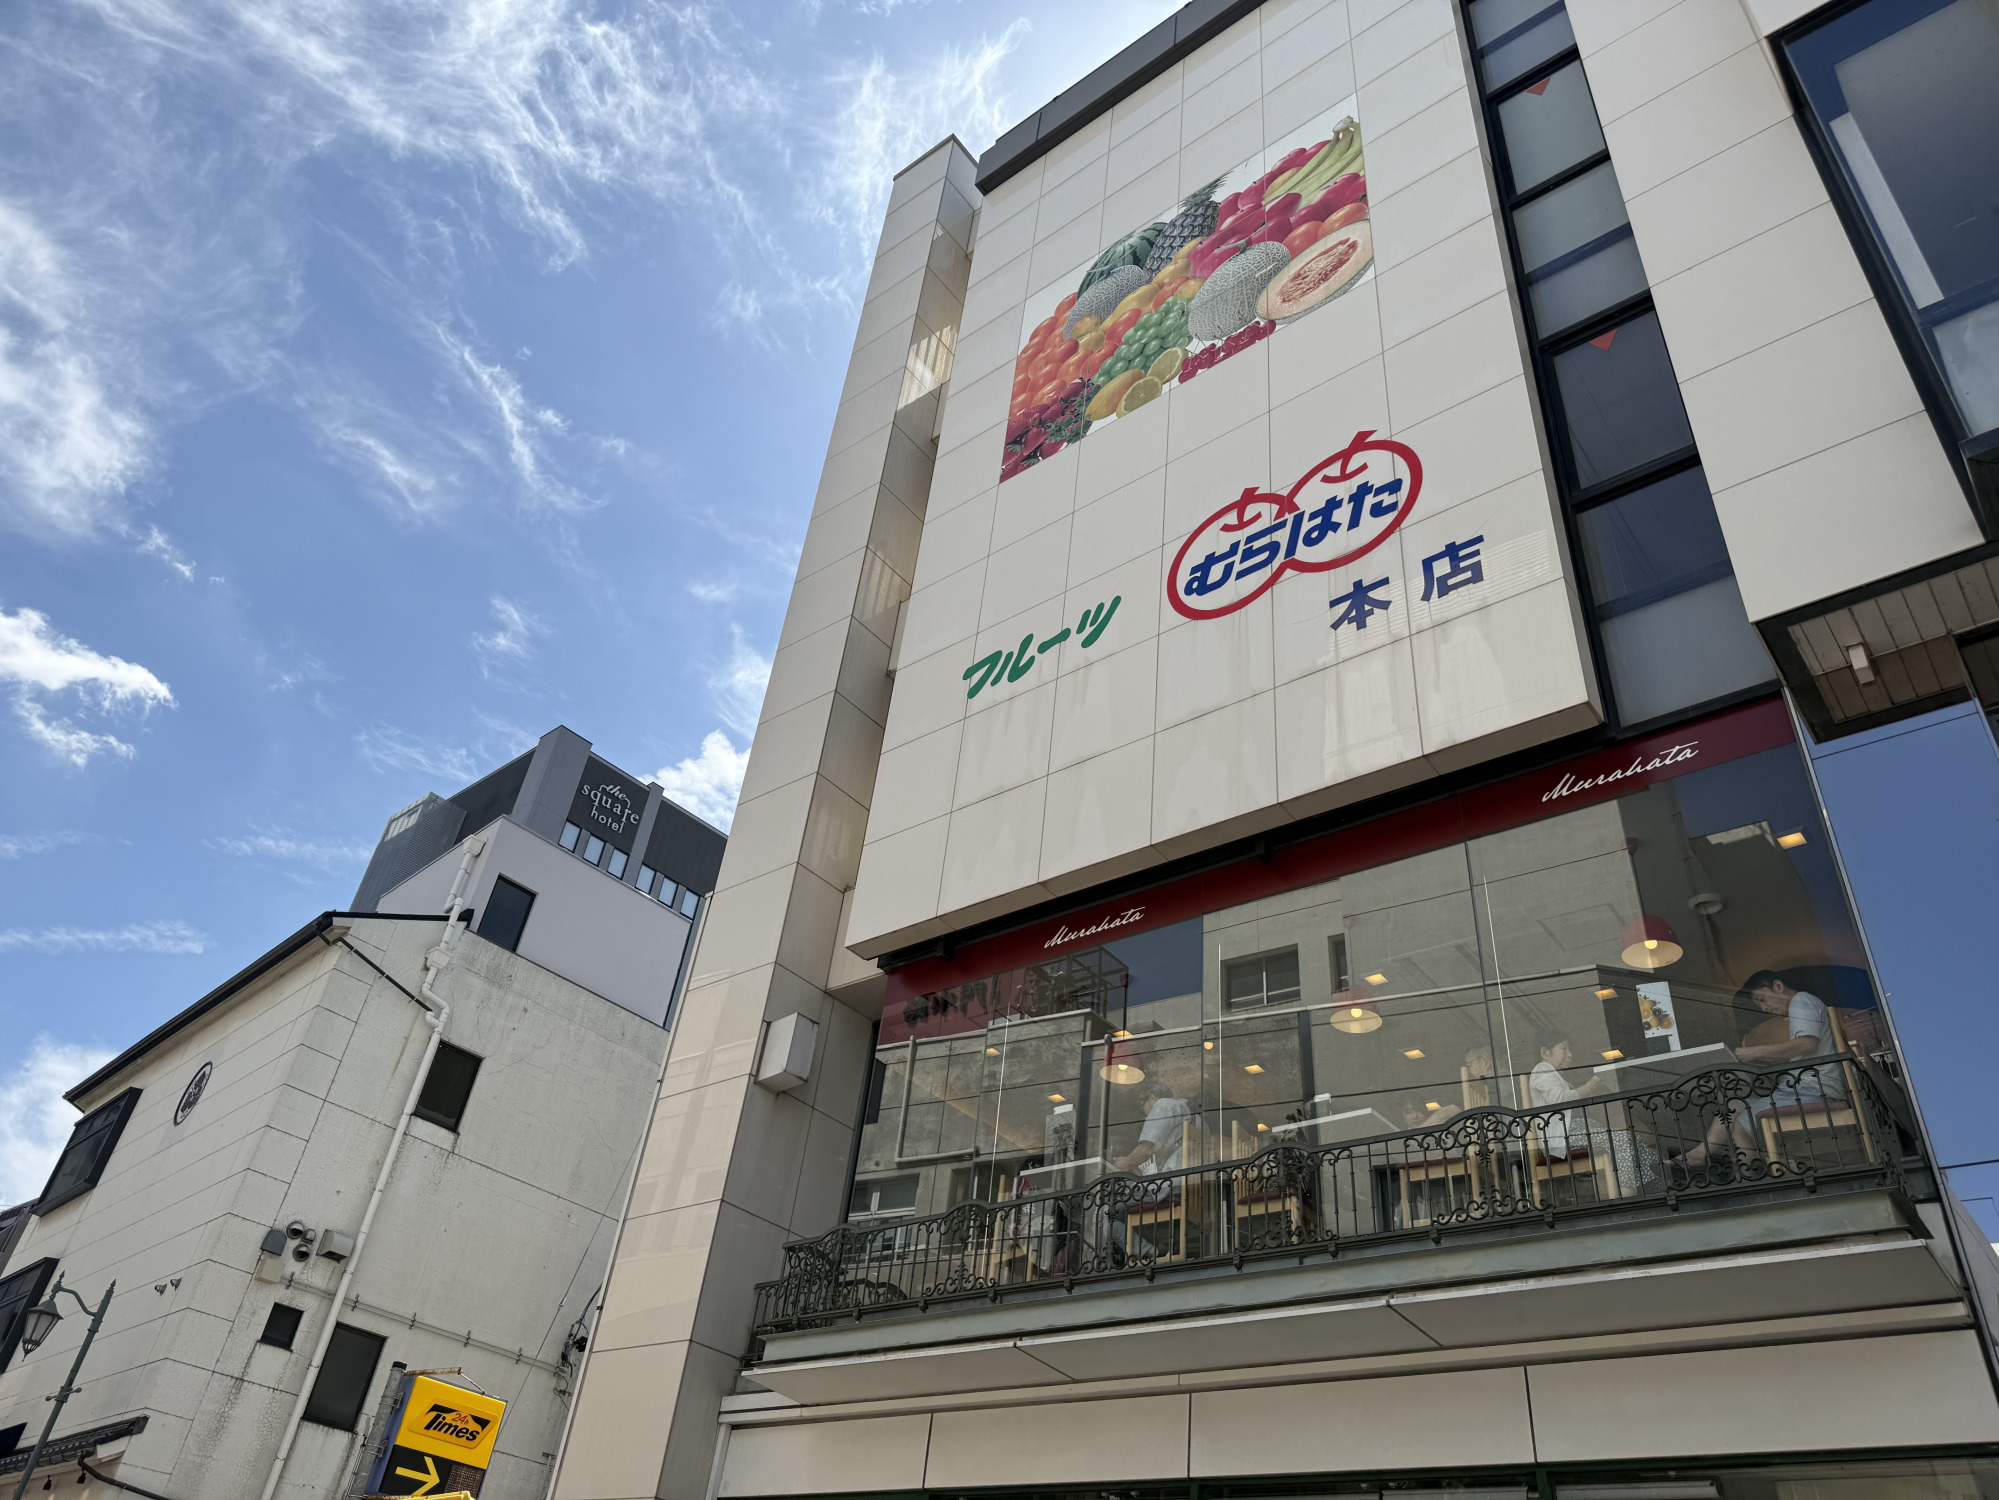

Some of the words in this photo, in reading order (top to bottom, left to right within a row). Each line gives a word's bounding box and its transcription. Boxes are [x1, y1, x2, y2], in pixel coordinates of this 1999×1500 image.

[1184, 479, 1402, 597] むらはた
[1329, 534, 1485, 630] 本店
[963, 595, 1121, 699] フルーツ
[1541, 741, 1699, 803] Murahata
[581, 784, 640, 824] square
[590, 806, 625, 833] hotel
[1044, 906, 1146, 949] Murahata
[424, 1404, 482, 1441] Times
[451, 1412, 469, 1425] 24h
